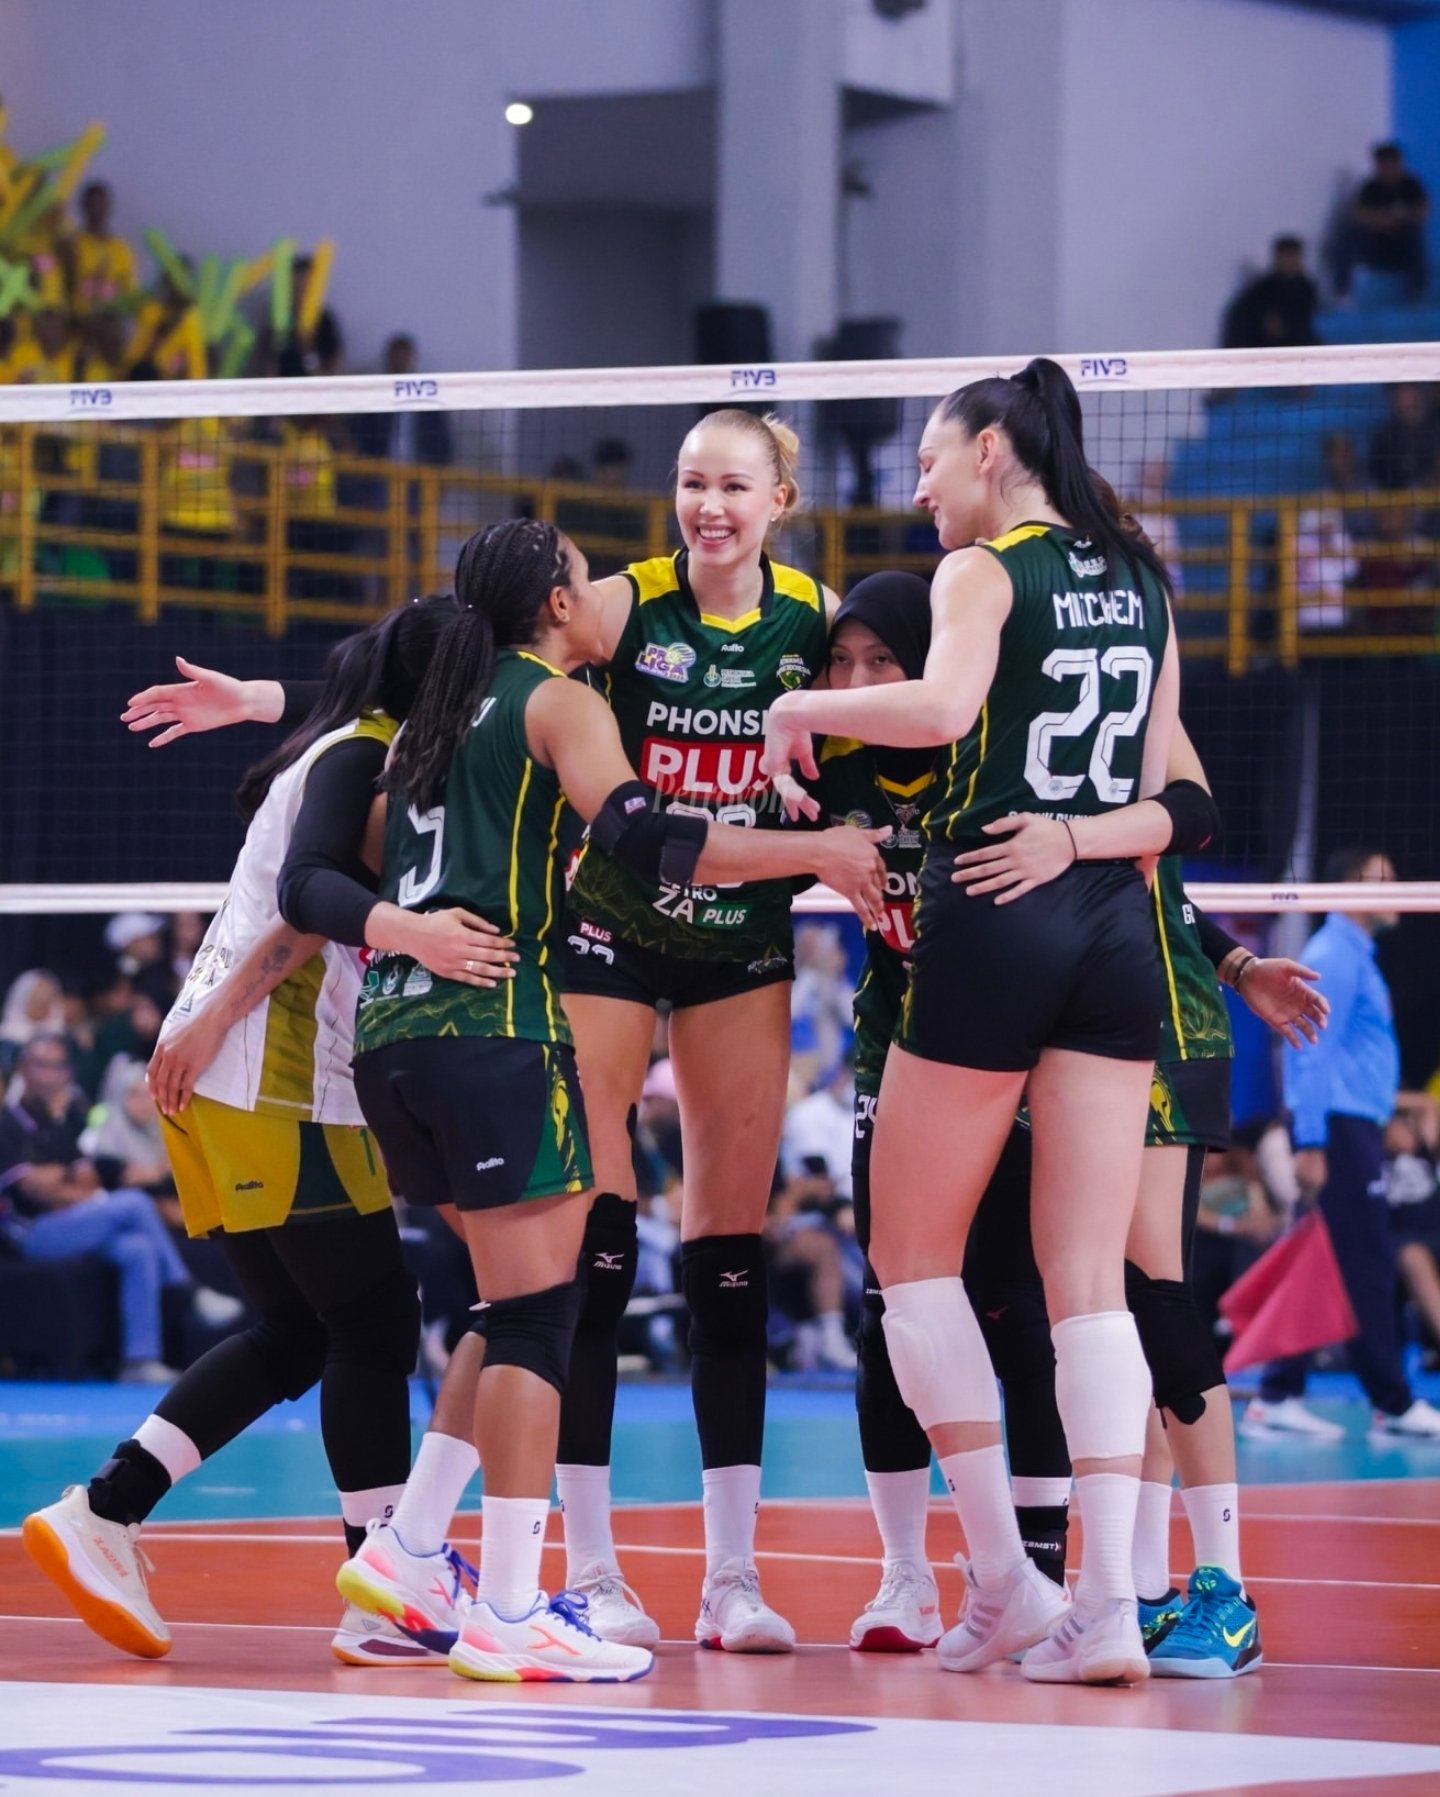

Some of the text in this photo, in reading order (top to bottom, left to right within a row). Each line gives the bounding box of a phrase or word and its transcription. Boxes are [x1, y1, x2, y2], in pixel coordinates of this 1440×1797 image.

[1081, 358, 1127, 375] FIVB
[731, 370, 776, 387] FIVB
[395, 381, 438, 397] FIVB
[1024, 645, 1154, 804] 22
[702, 908, 747, 925] PLUS
[580, 922, 612, 942] PLUS
